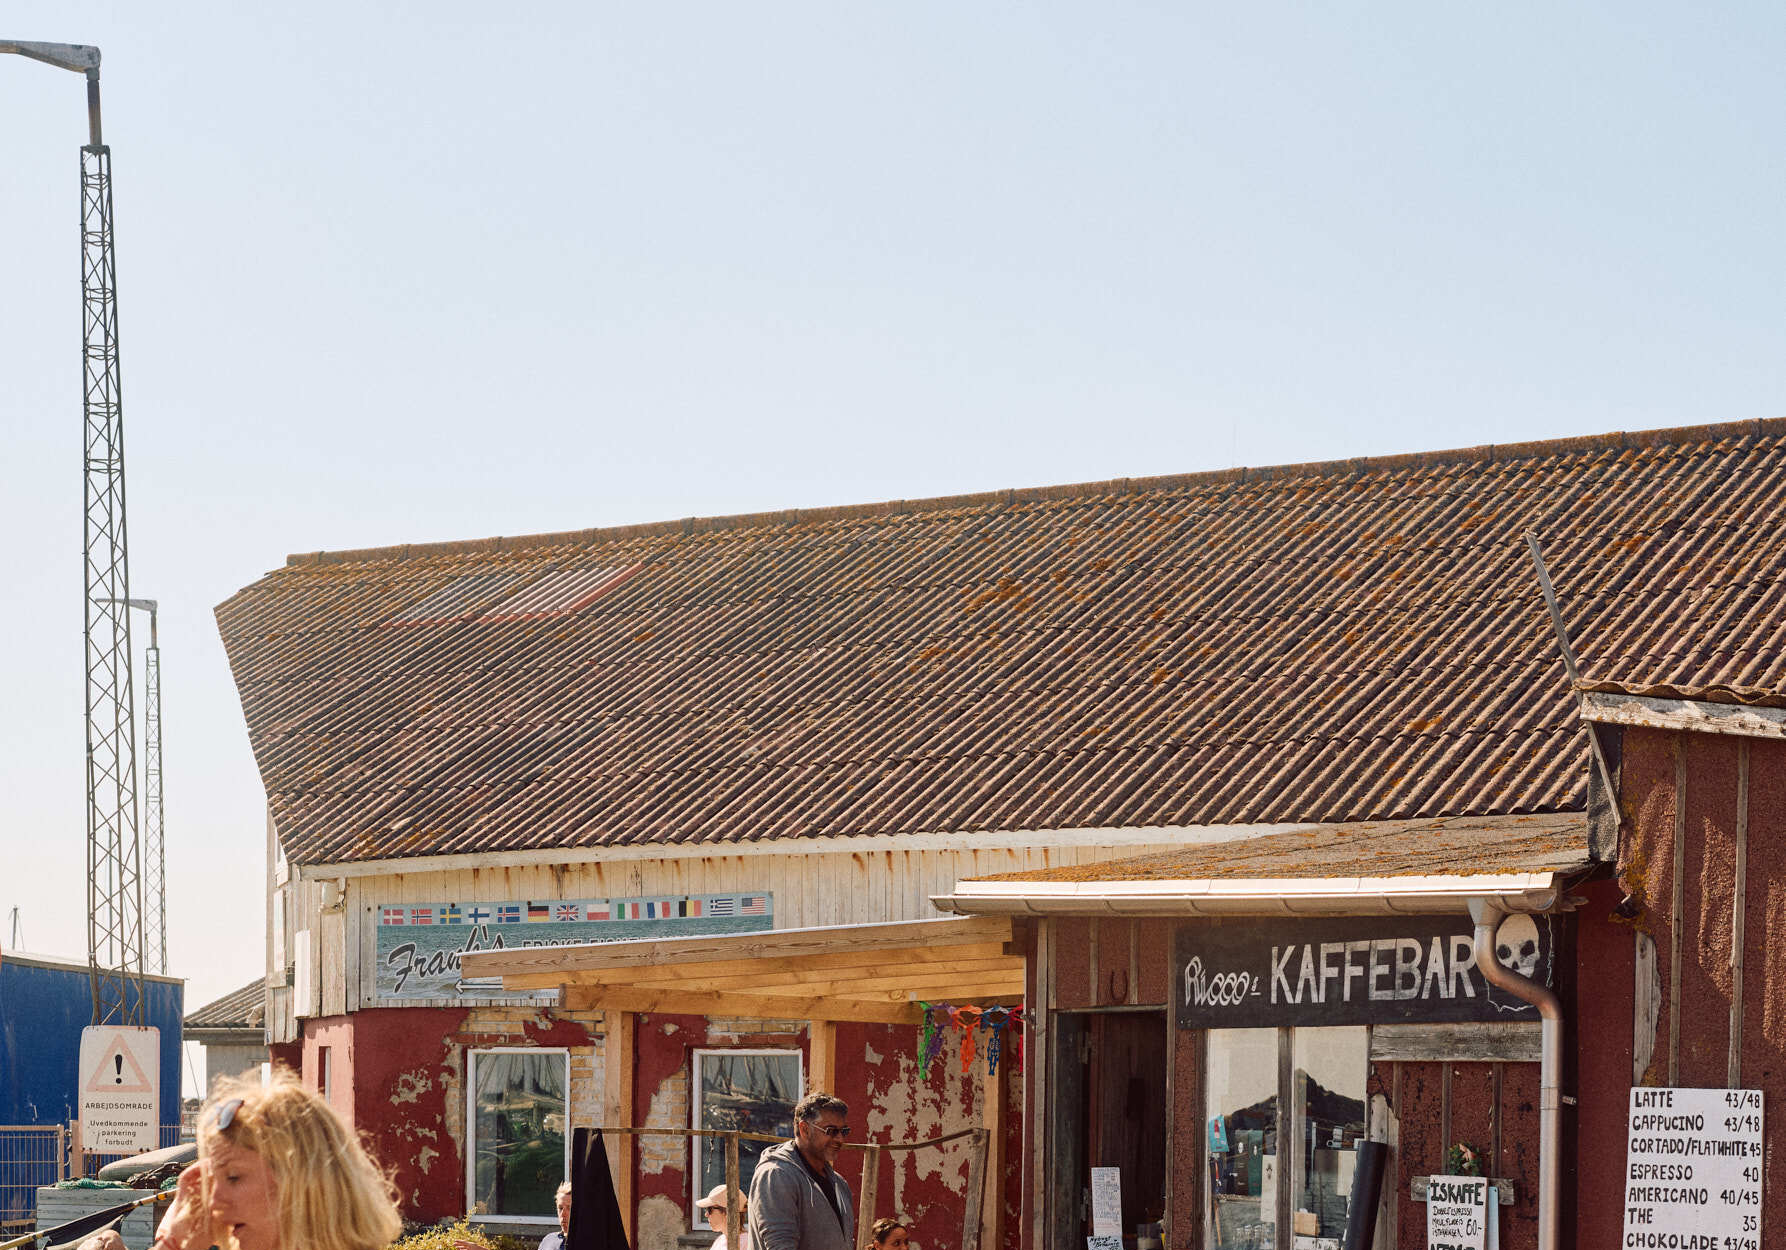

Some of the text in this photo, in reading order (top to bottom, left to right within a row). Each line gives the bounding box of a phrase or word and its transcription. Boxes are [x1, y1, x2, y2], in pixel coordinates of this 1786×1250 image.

[1271, 935, 1477, 1004] KAFFEBAR
[1635, 1090, 1760, 1109] LATTE 43/48
[1633, 1114, 1760, 1133] CAPPUCINO 43/48
[1631, 1138, 1761, 1157] CORTADO/FLATWHITE 45
[1630, 1163, 1759, 1183] ESPRESSO 40
[1430, 1181, 1485, 1206] ISKAFFE
[1628, 1187, 1759, 1206] AMERICANO 40/45
[1628, 1208, 1757, 1232] THE 35
[1626, 1233, 1718, 1250] CHOKOLADE
